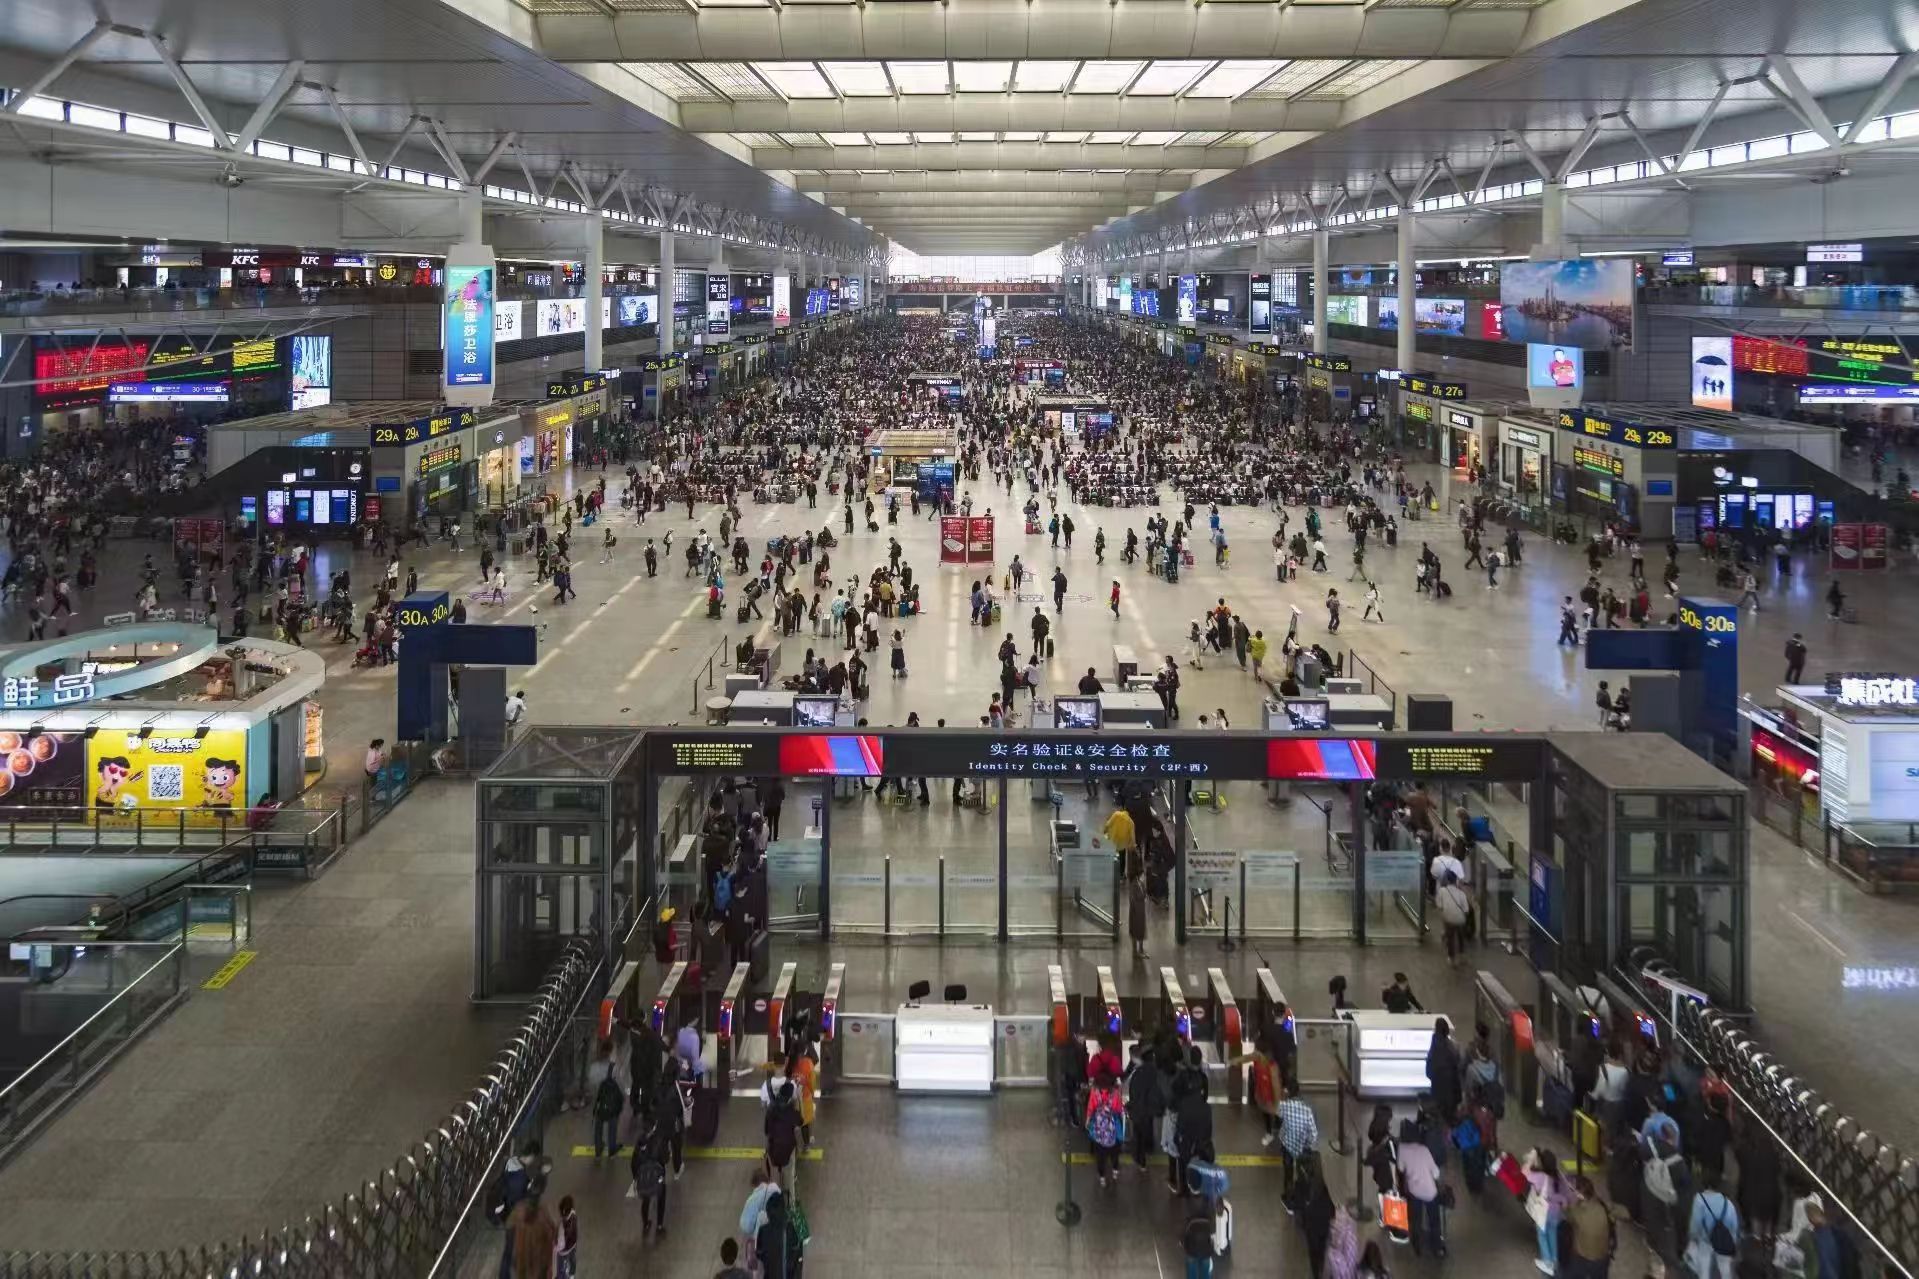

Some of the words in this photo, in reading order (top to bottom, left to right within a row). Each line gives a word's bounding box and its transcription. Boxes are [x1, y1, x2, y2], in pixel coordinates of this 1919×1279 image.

[231, 255, 259, 265] KFC
[301, 256, 320, 265] KFC
[550, 385, 567, 396] 27A
[1445, 385, 1464, 397] 27B
[375, 428, 400, 442] 29A
[1647, 430, 1673, 444] 29B
[400, 610, 429, 626] 30A
[431, 603, 448, 624] 30A
[1679, 607, 1703, 630] 30B
[1705, 615, 1736, 632] 30B
[968, 762, 1025, 771] Identity
[1032, 762, 1068, 771] Check
[1089, 763, 1147, 772] Security
